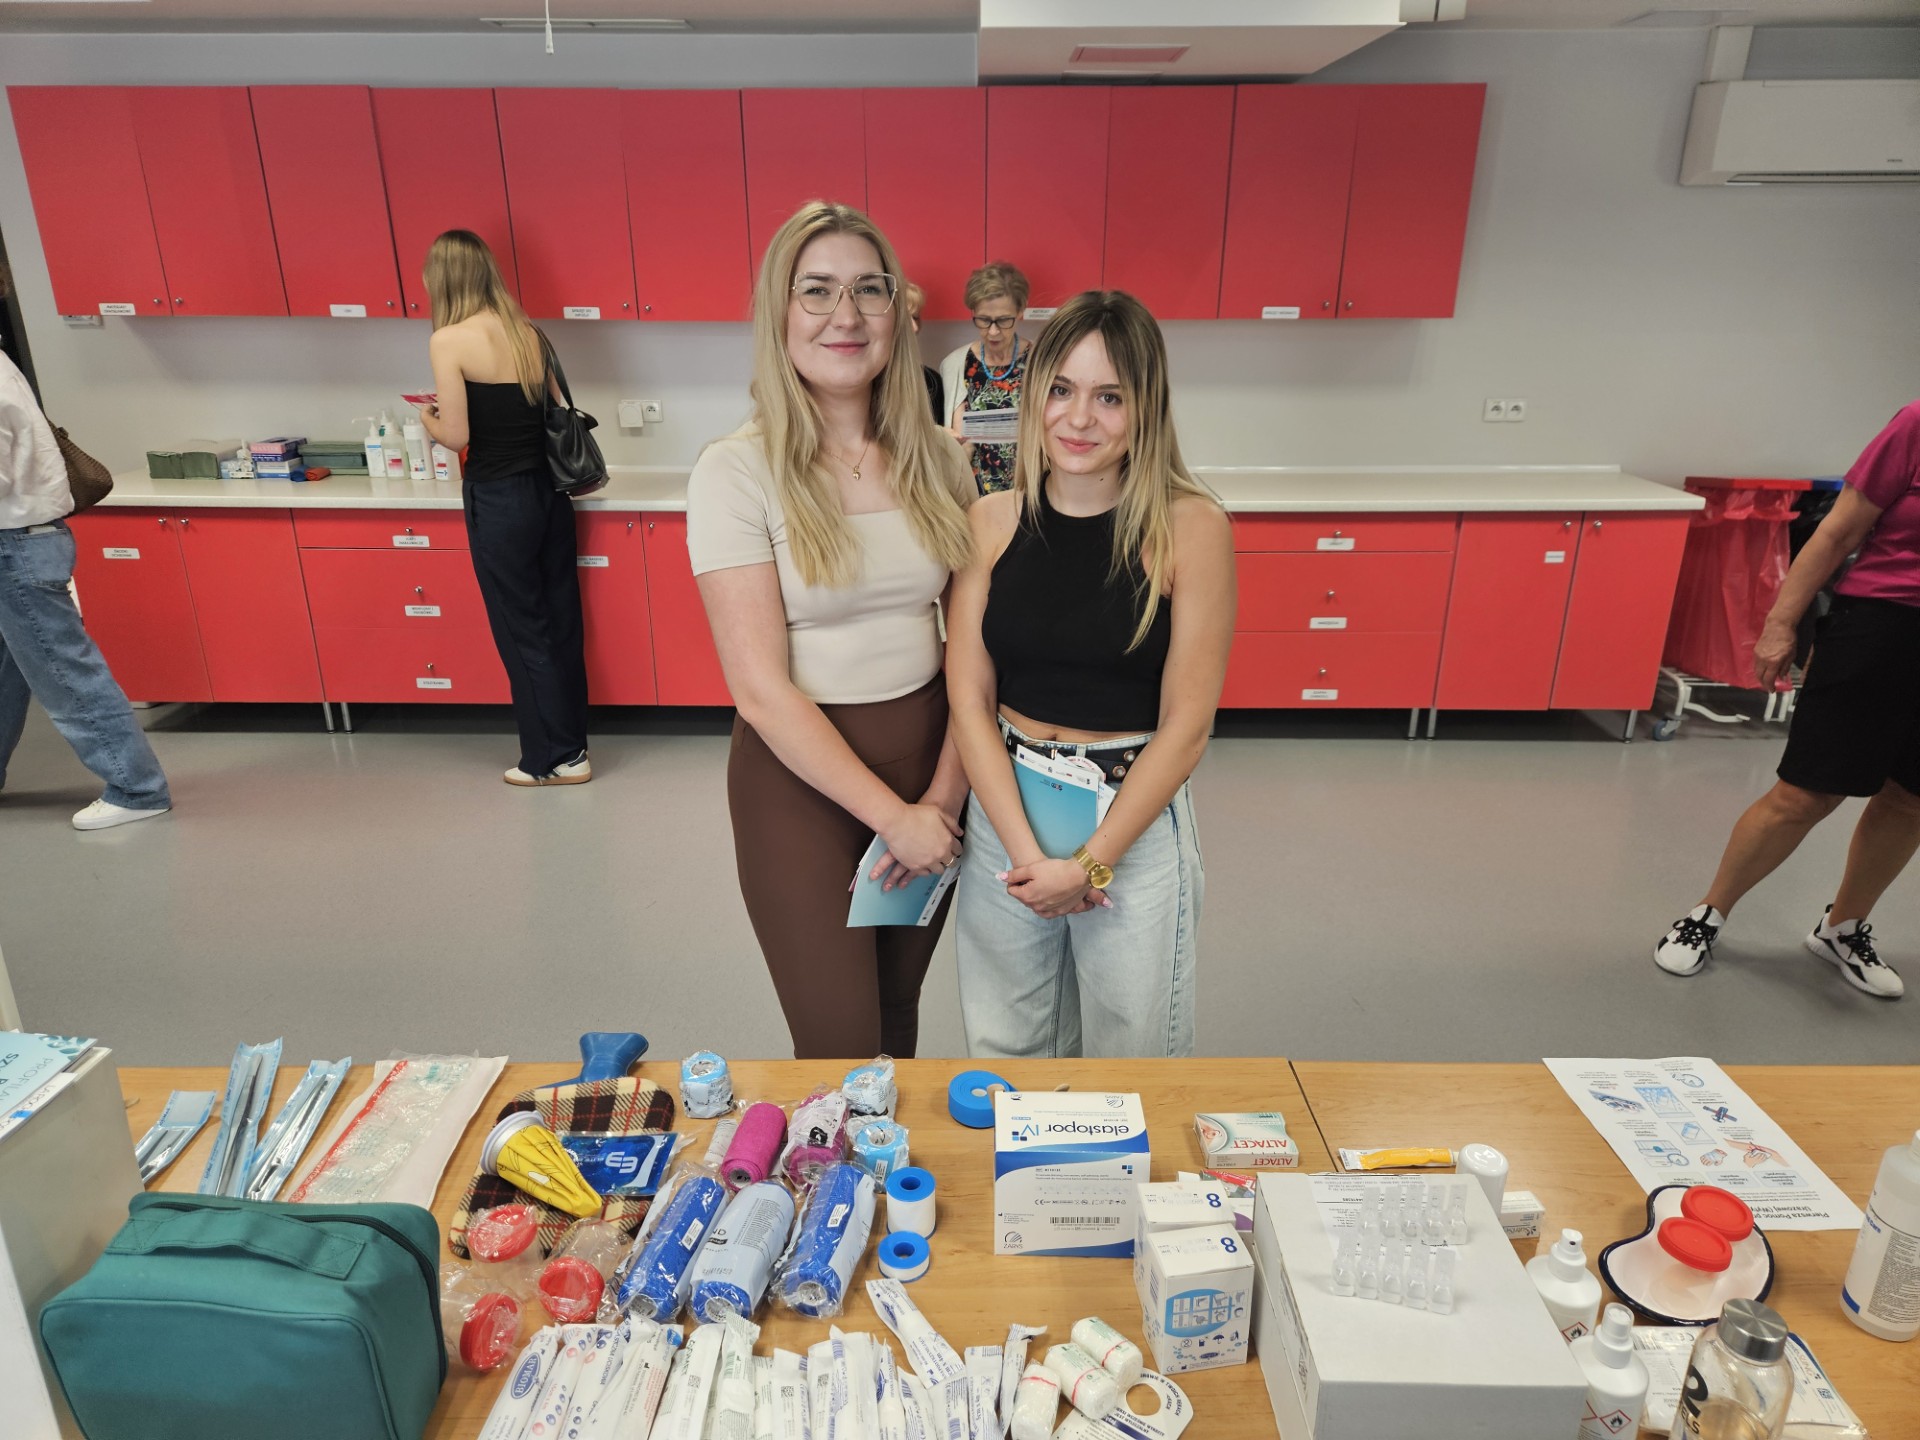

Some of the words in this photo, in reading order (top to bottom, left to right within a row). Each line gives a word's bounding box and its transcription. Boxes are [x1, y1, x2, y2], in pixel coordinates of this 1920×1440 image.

[0, 1057, 54, 1102] PROFILA
[1021, 1124, 1039, 1136] IV
[1045, 1121, 1129, 1137] elastopor
[1233, 1139, 1287, 1149] ALTACET
[1253, 1158, 1293, 1166] ALTACET
[1206, 1192, 1222, 1208] 8
[1750, 1205, 1774, 1213] (Wyty
[1773, 1206, 1812, 1214] Urazowej
[1791, 1212, 1830, 1220] Pierwsza
[1220, 1237, 1238, 1254] 8
[515, 1356, 538, 1395] BIOMAR
[1679, 1404, 1701, 1434] ELS
